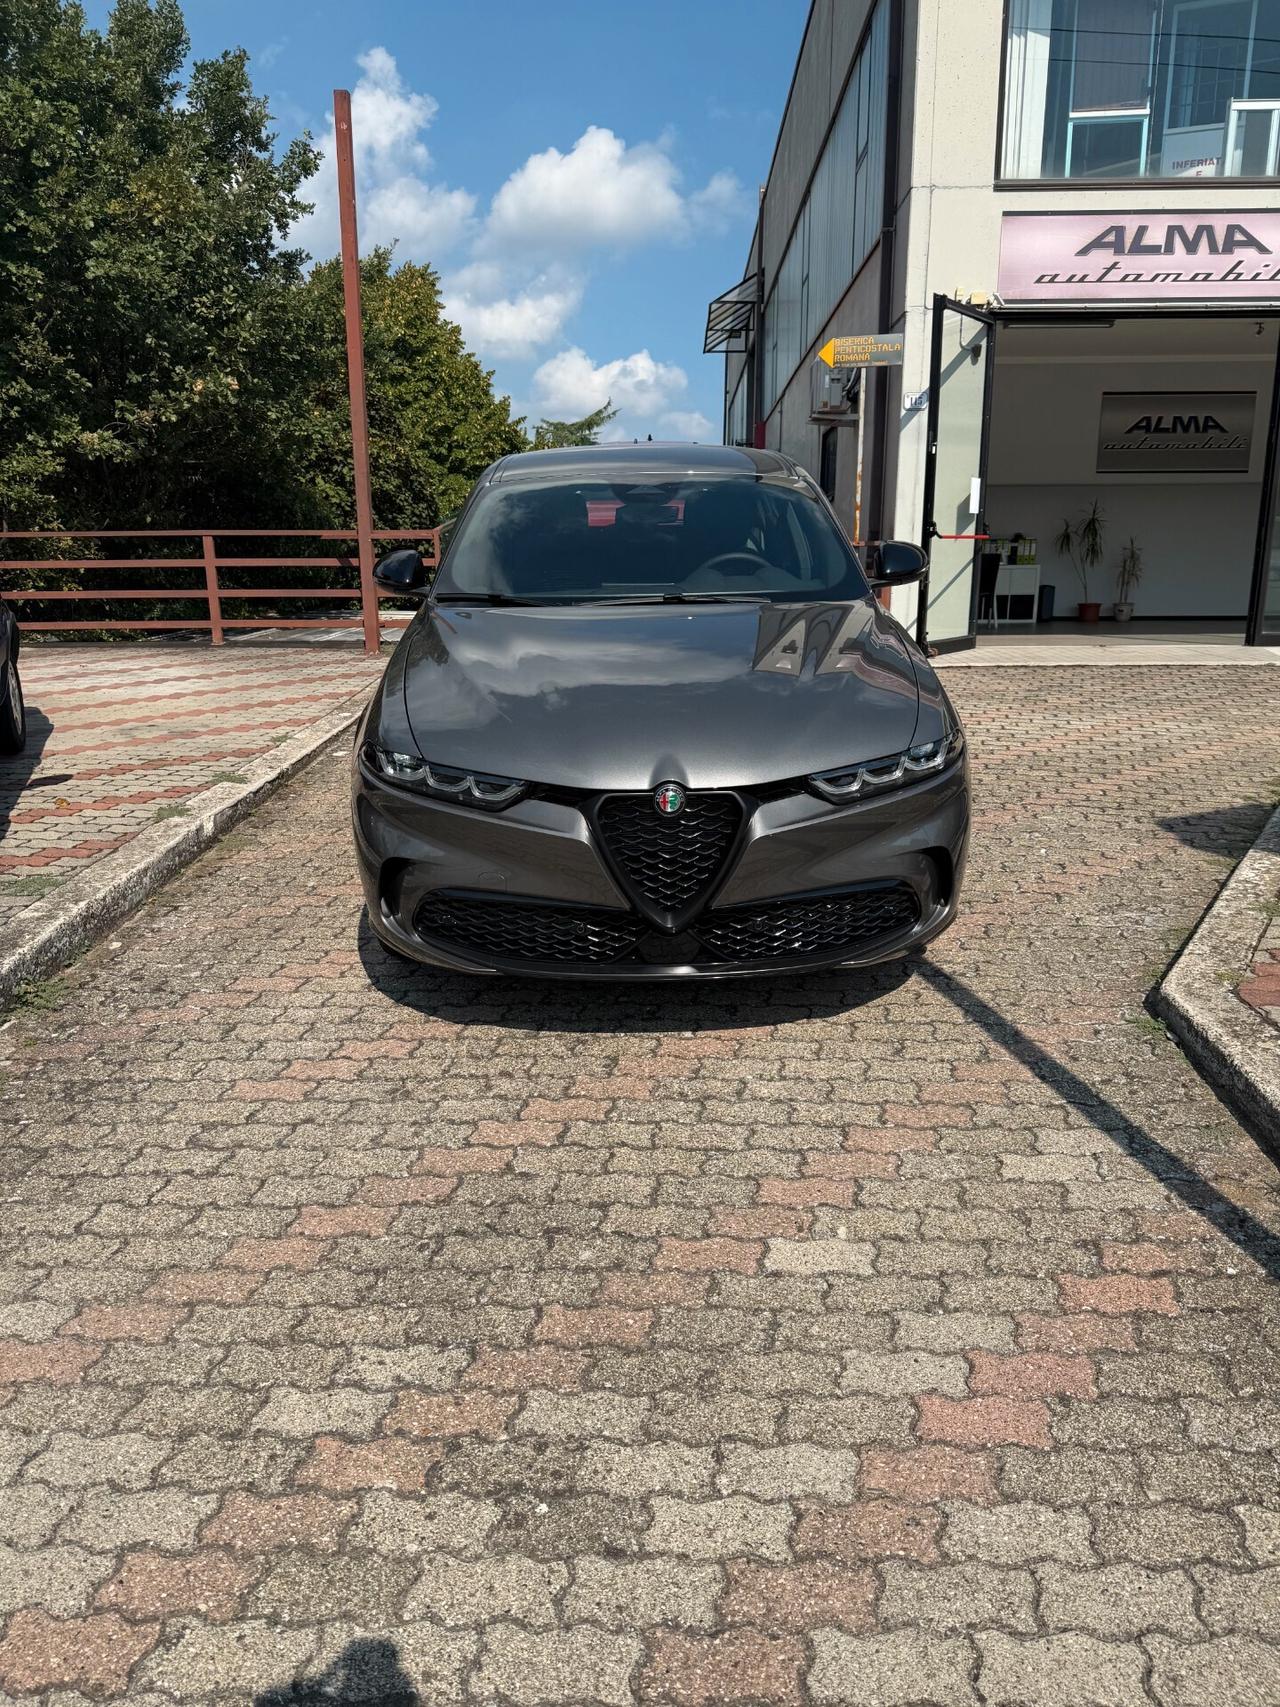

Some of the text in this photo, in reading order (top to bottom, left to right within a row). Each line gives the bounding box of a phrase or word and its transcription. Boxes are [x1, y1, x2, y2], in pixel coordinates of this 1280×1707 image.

[1074, 223, 1274, 256] ALMA
[834, 336, 875, 347] BISERICA
[834, 343, 901, 354] PENTICOSTALA
[834, 352, 871, 363] ROMANA
[1124, 415, 1230, 434] ALMA
[1103, 434, 1249, 450] automobili
